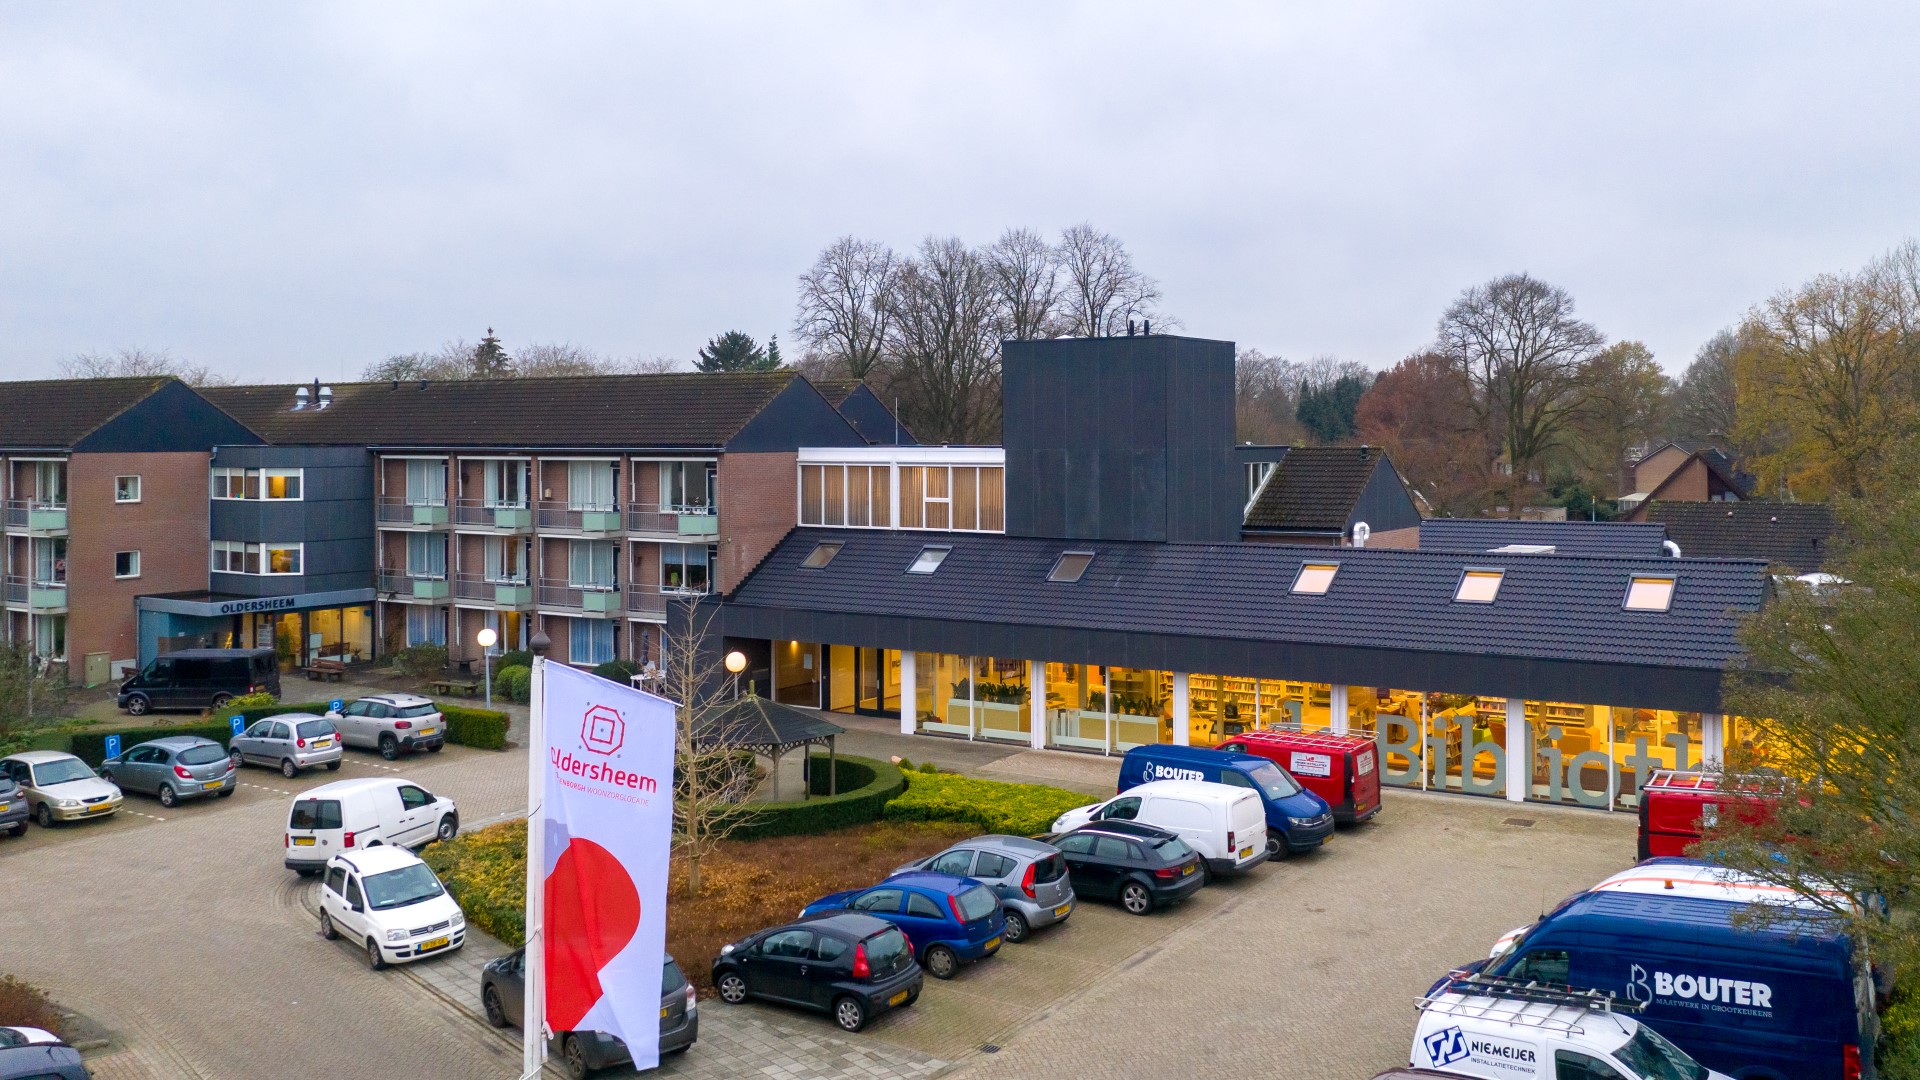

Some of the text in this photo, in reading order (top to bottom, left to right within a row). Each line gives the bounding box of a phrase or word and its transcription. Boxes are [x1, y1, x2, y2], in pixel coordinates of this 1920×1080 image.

[221, 598, 295, 614] OLDERSHEEM
[233, 718, 241, 730] P
[108, 738, 117, 750] P
[1155, 765, 1205, 781] BOUTER
[1654, 971, 1773, 1008] BOUTER
[1656, 998, 1773, 1018] MAATWERK IN GROOTKEUKENS
[1471, 1040, 1536, 1063] NIEMEIJER
[1470, 1057, 1536, 1075] INSTALLATIETECHNIEK
